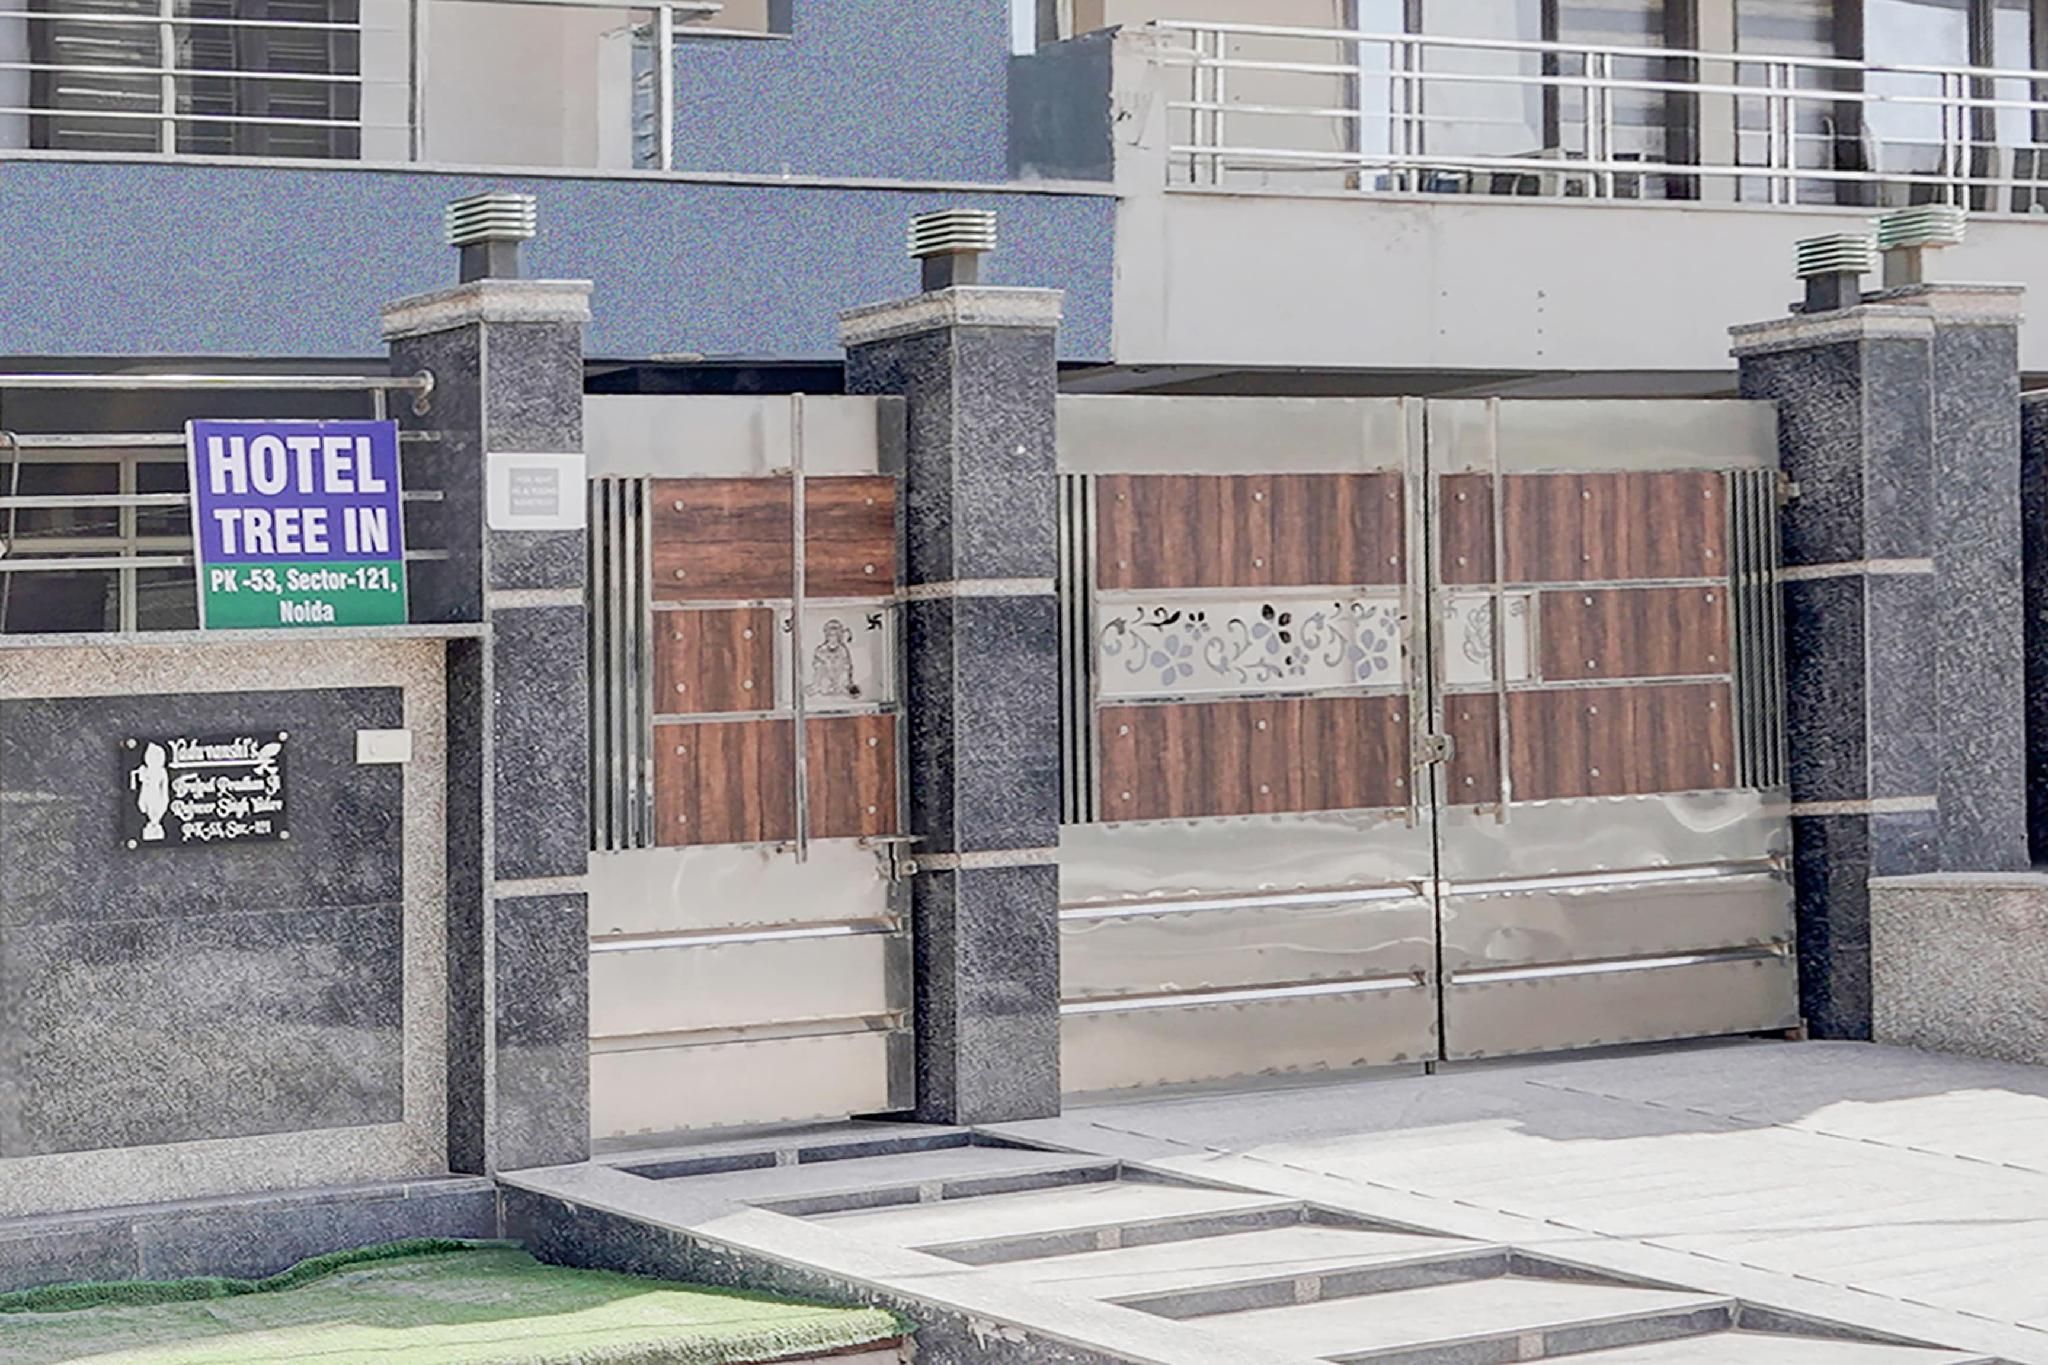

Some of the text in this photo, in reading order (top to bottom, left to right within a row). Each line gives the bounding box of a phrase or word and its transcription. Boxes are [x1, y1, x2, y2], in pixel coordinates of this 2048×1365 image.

[208, 434, 386, 495] HOTEL
[213, 508, 389, 554] TREE IN
[286, 567, 398, 593] Sector-121,
[279, 600, 335, 623] Noida
